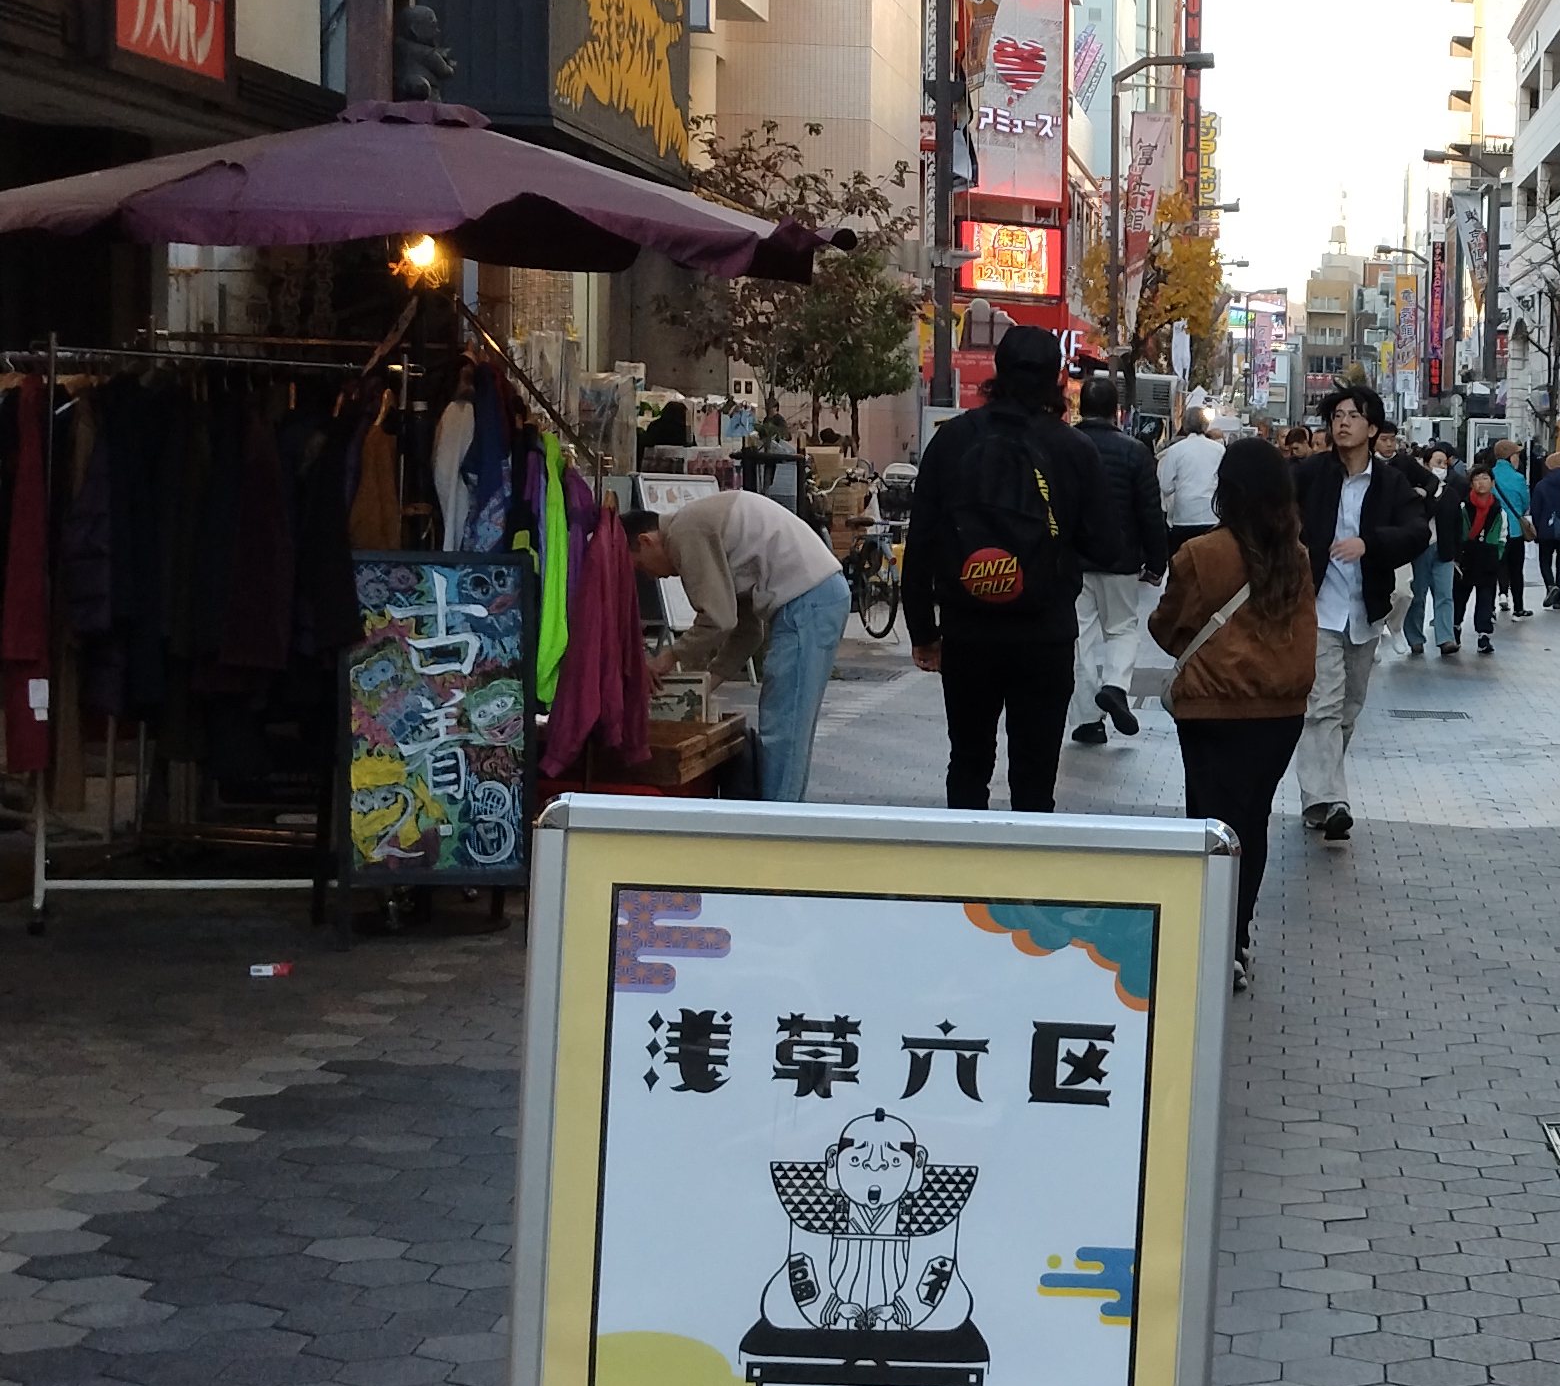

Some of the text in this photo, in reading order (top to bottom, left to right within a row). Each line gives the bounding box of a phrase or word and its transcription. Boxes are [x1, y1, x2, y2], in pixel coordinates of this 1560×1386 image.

[977, 106, 1062, 139] アミューズ
[1127, 142, 1159, 232] 富士館
[960, 556, 1018, 581] SANTA
[970, 577, 1017, 596] CRUZ
[386, 569, 490, 801] 古着
[643, 1006, 1117, 1108] 浅草六区
